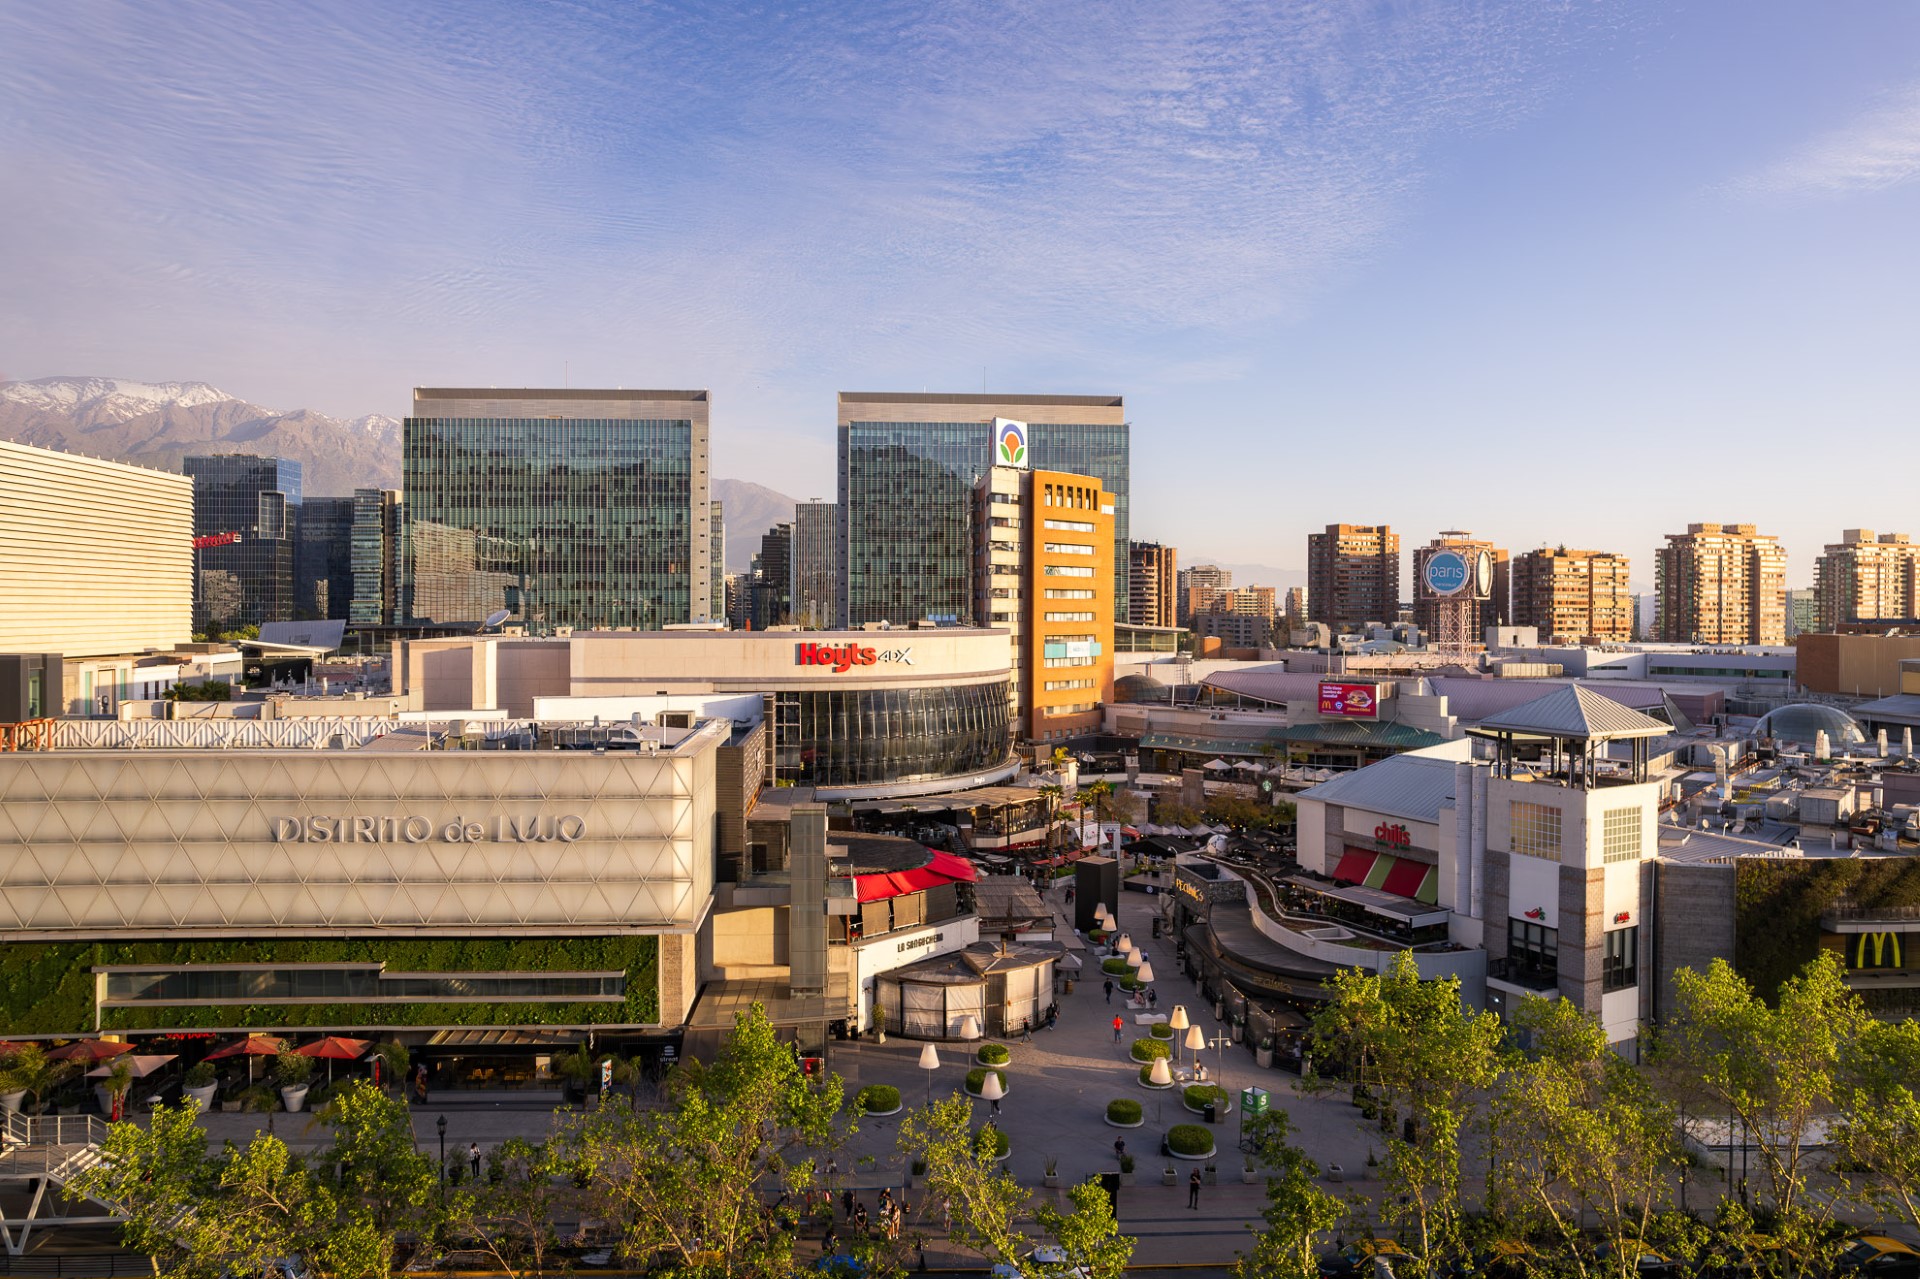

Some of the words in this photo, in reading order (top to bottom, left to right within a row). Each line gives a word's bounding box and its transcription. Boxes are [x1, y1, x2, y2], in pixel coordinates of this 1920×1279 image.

[1429, 566, 1463, 580] paris
[798, 642, 877, 673] Hoyts
[877, 646, 916, 666] 4DX
[275, 815, 432, 843] DISTRITO
[444, 816, 485, 843] de
[498, 815, 587, 843] LUJO
[1374, 821, 1411, 846] chili's
